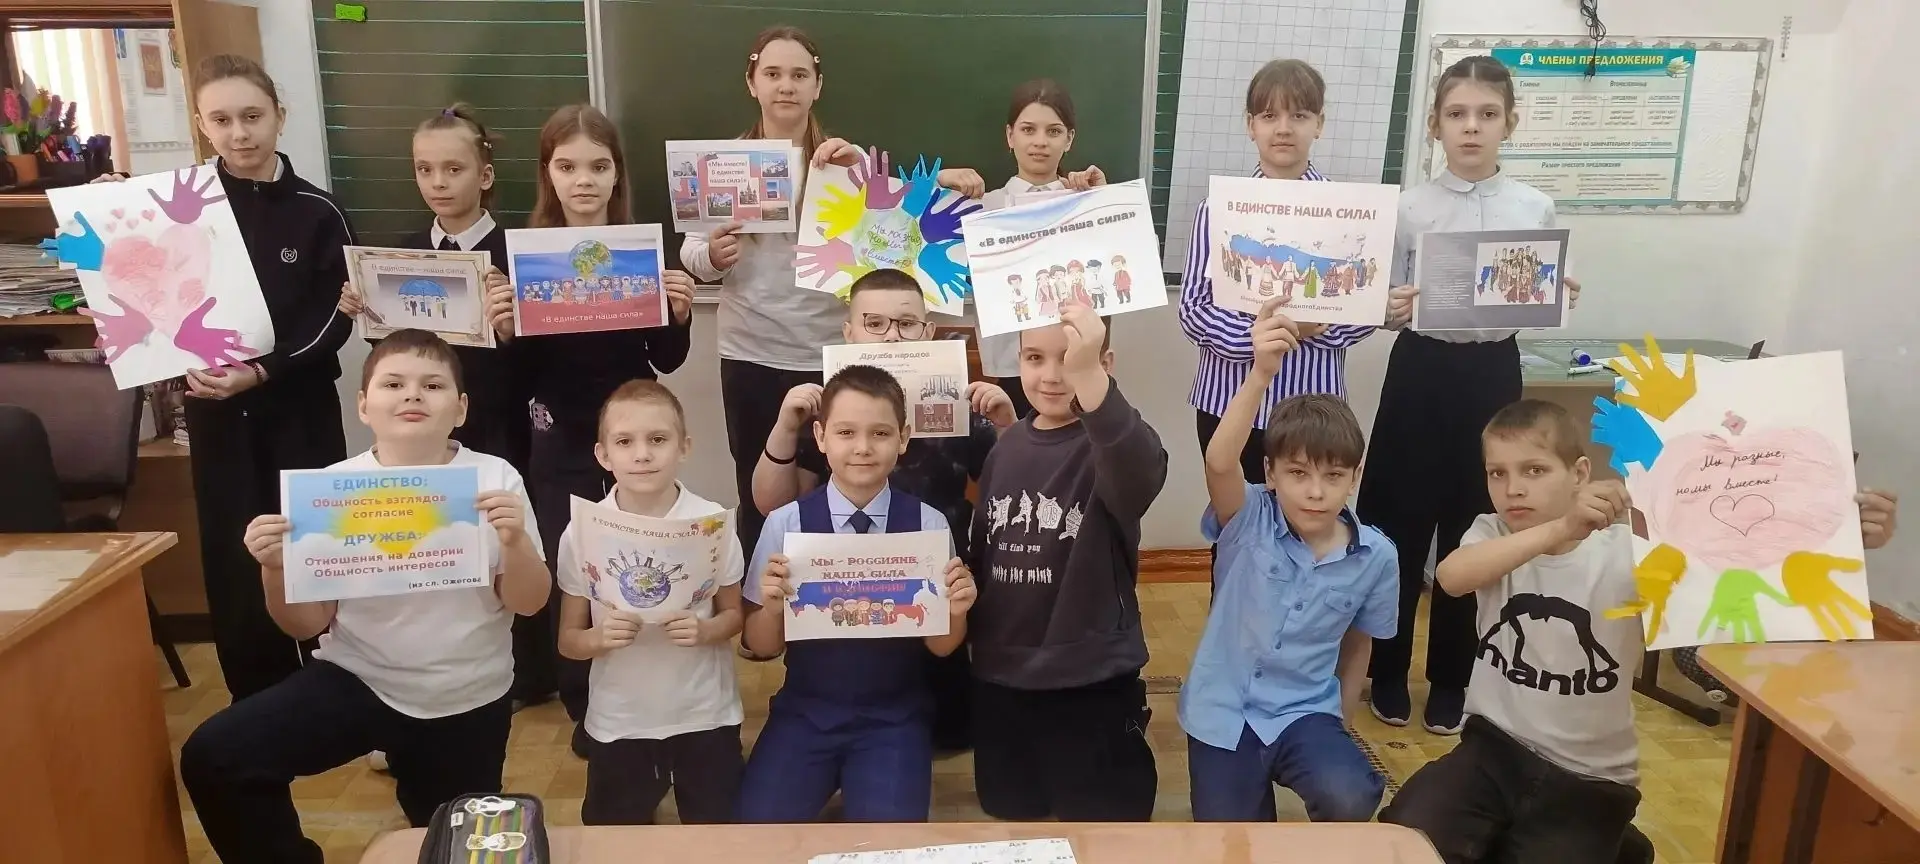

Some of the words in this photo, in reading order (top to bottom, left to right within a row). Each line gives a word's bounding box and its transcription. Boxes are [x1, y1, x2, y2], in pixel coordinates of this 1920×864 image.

[1538, 55, 1576, 65] ЧЛЕНЫ
[1578, 55, 1664, 66] ПРЕДЛОЖЕНИЯ
[1227, 201, 1234, 212] В
[1236, 201, 1291, 216] ЕДИНСТВЕ
[1294, 205, 1333, 219] НАША
[1336, 208, 1377, 220] СИЛА!
[979, 237, 995, 249] «В
[998, 227, 1058, 245] единстве
[1059, 220, 1094, 234] наша
[1097, 210, 1137, 226] сила»
[554, 315, 594, 323] единстве
[595, 312, 618, 320] наша
[620, 311, 643, 319] сила»
[859, 352, 893, 361] Дружба
[895, 351, 931, 360] народов
[1699, 454, 1723, 472] Мы
[333, 476, 428, 491] ЕДИНСТВО:
[1723, 474, 1778, 492] вместе!
[312, 497, 383, 509] Общность
[386, 494, 449, 505] взглядов
[352, 508, 414, 519] согласие
[343, 531, 425, 547] ДРУЖБА:
[641, 529, 670, 539] НАША
[304, 554, 384, 567] Отношения
[388, 552, 404, 561] на
[408, 547, 464, 561] доверии
[811, 558, 834, 567] МЫ
[847, 556, 919, 566] РОССИЯНЕ,
[314, 565, 384, 579] Общность
[388, 560, 456, 573] интересов
[822, 570, 866, 580] НАША
[870, 569, 907, 578] СИЛА
[1476, 641, 1619, 695] manto
